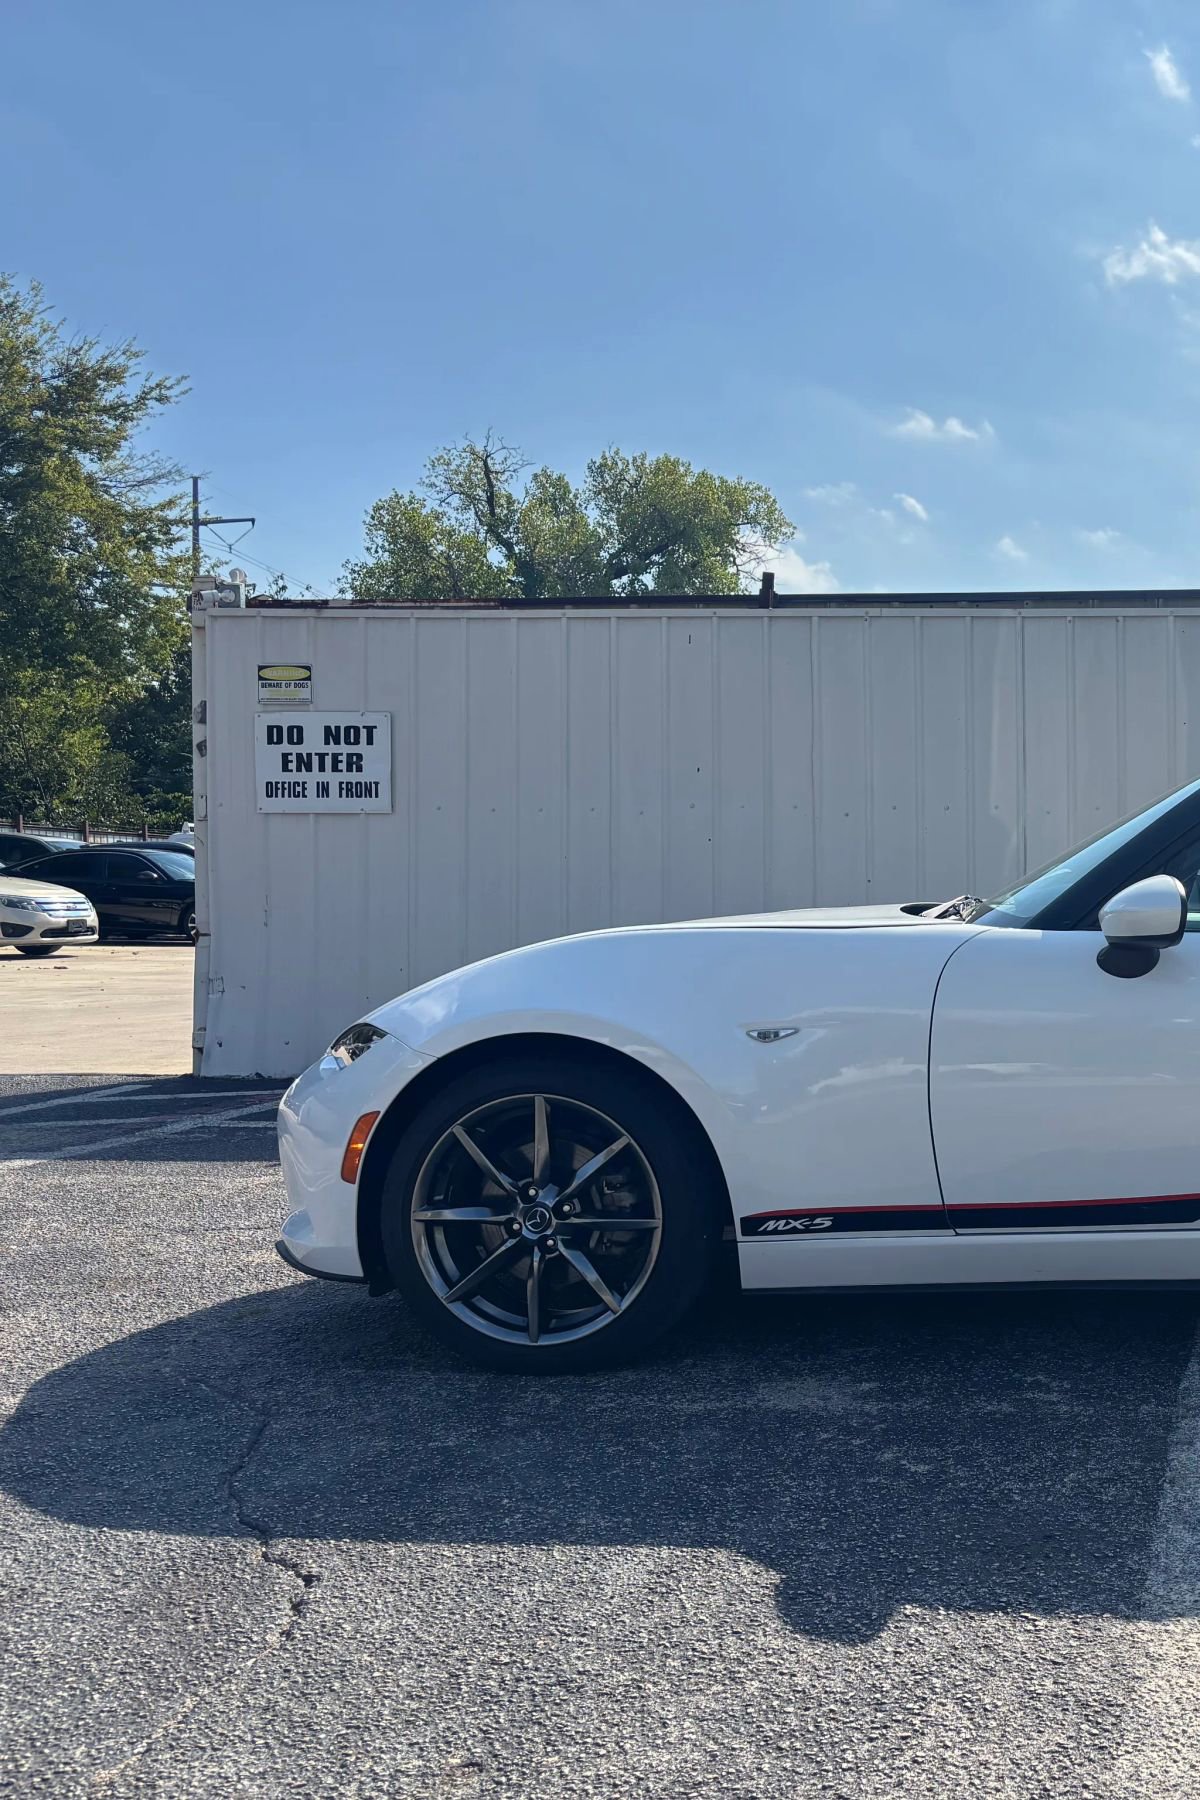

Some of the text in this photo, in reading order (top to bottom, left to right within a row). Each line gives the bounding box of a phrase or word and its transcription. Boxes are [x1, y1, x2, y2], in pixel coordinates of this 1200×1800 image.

[266, 725, 377, 746] DO NOT
[281, 752, 364, 773] ENTER
[265, 781, 380, 799] OFFICE IN FRONT
[757, 1216, 834, 1232] MX-5
